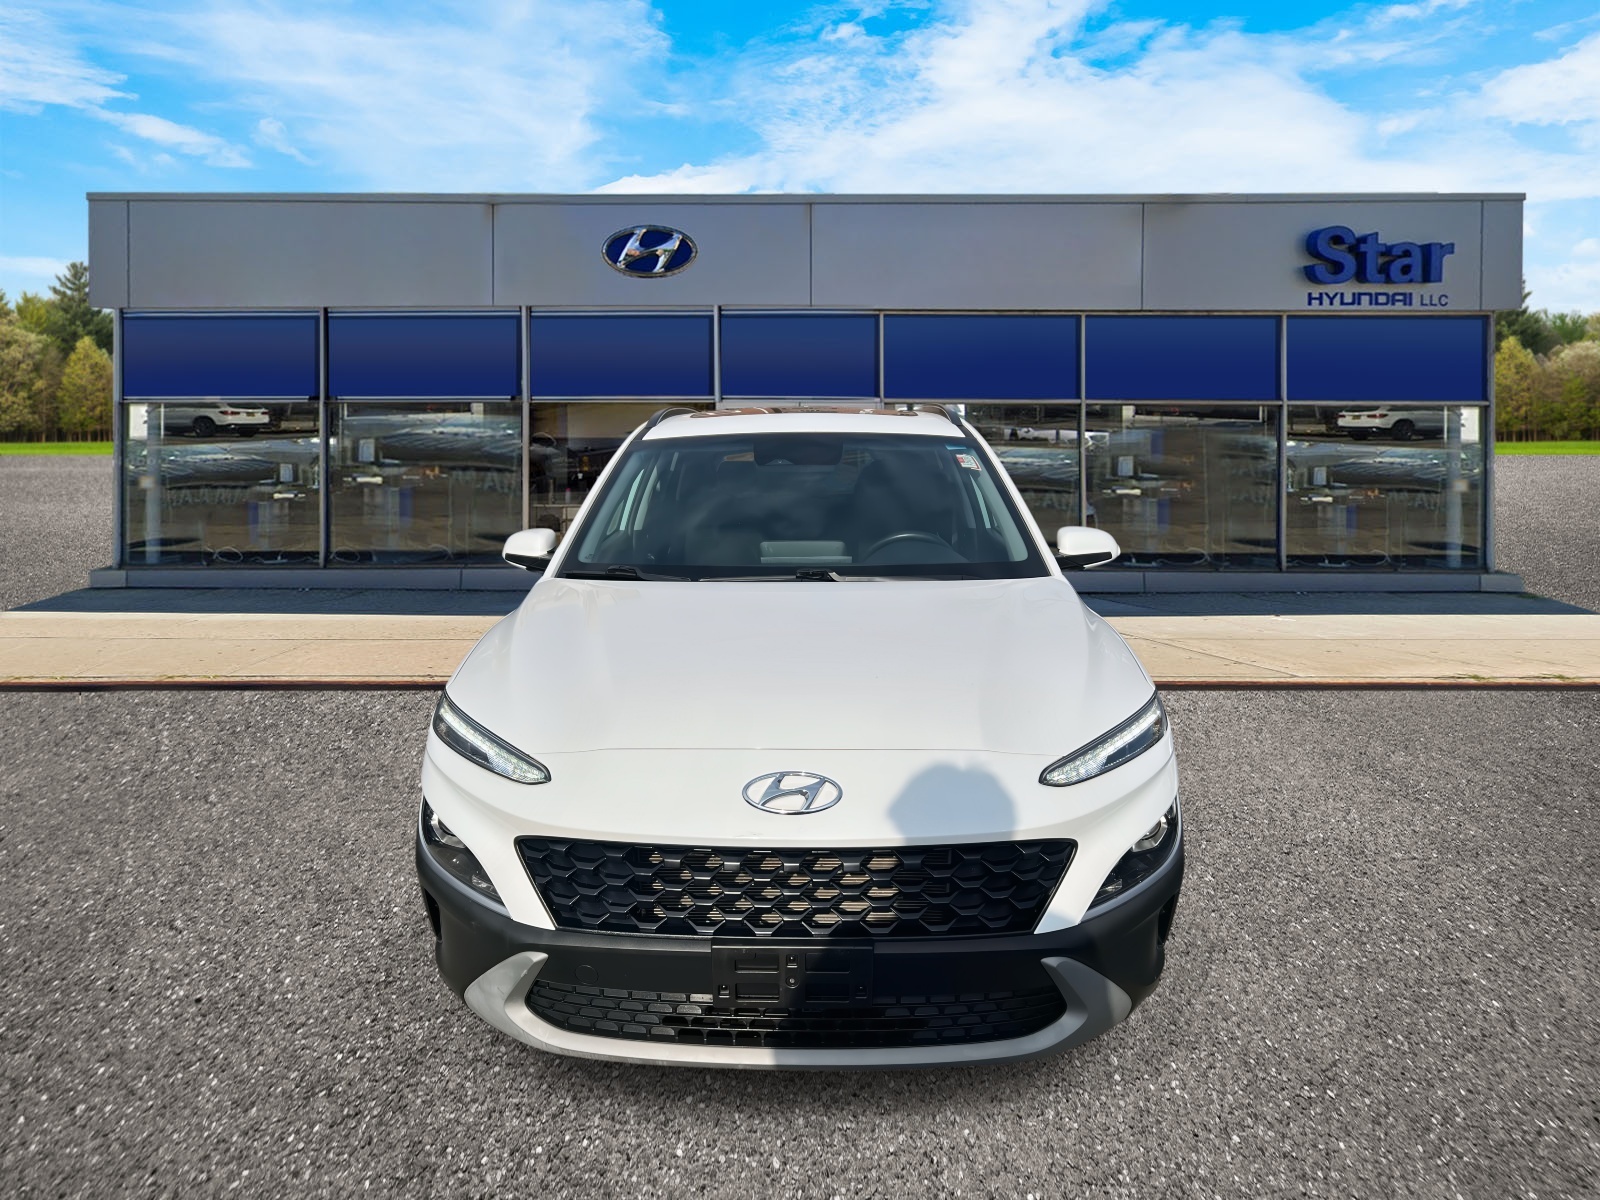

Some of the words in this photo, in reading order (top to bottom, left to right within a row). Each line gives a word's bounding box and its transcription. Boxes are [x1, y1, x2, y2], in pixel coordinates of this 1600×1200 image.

[1303, 225, 1455, 284] Star
[1307, 292, 1413, 306] HYUNDAI
[1420, 294, 1449, 306] LLC
